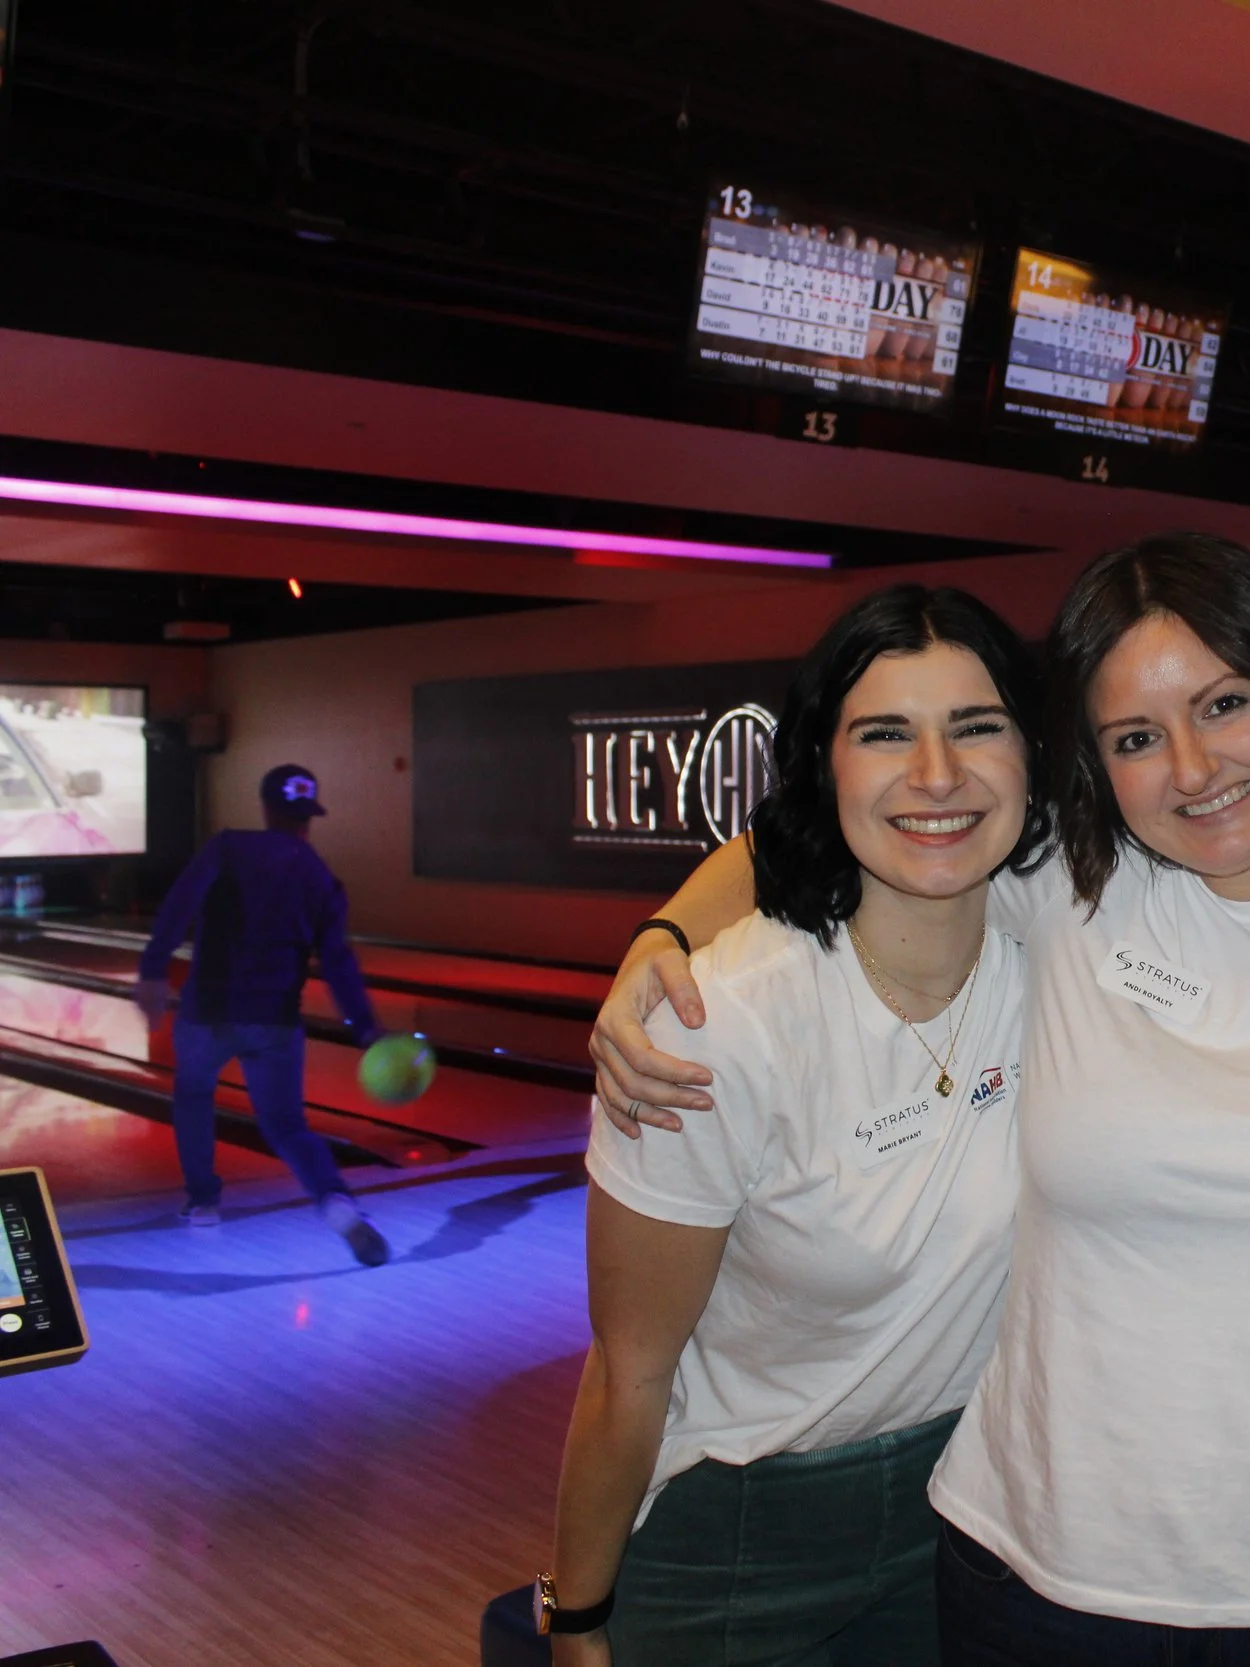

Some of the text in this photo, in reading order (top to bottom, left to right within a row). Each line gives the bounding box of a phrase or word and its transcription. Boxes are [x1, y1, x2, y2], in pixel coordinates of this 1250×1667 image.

[720, 185, 753, 219] 13
[1028, 261, 1053, 289] 14
[872, 280, 938, 321] DAY
[701, 349, 720, 361] WHY
[765, 360, 780, 371] THE
[782, 362, 817, 376] BICYCLE
[1141, 334, 1195, 375] DAY
[802, 410, 838, 442] 13
[1081, 456, 1109, 483] 14
[571, 729, 701, 831] HEY
[1123, 980, 1143, 994] ANDI
[1141, 987, 1174, 1008] ROYALTY
[1136, 960, 1200, 997] STRATUS
[971, 1072, 1003, 1105] NAHB
[874, 1100, 930, 1131] STRATUS
[878, 1129, 922, 1154] MARIE BRYANT
